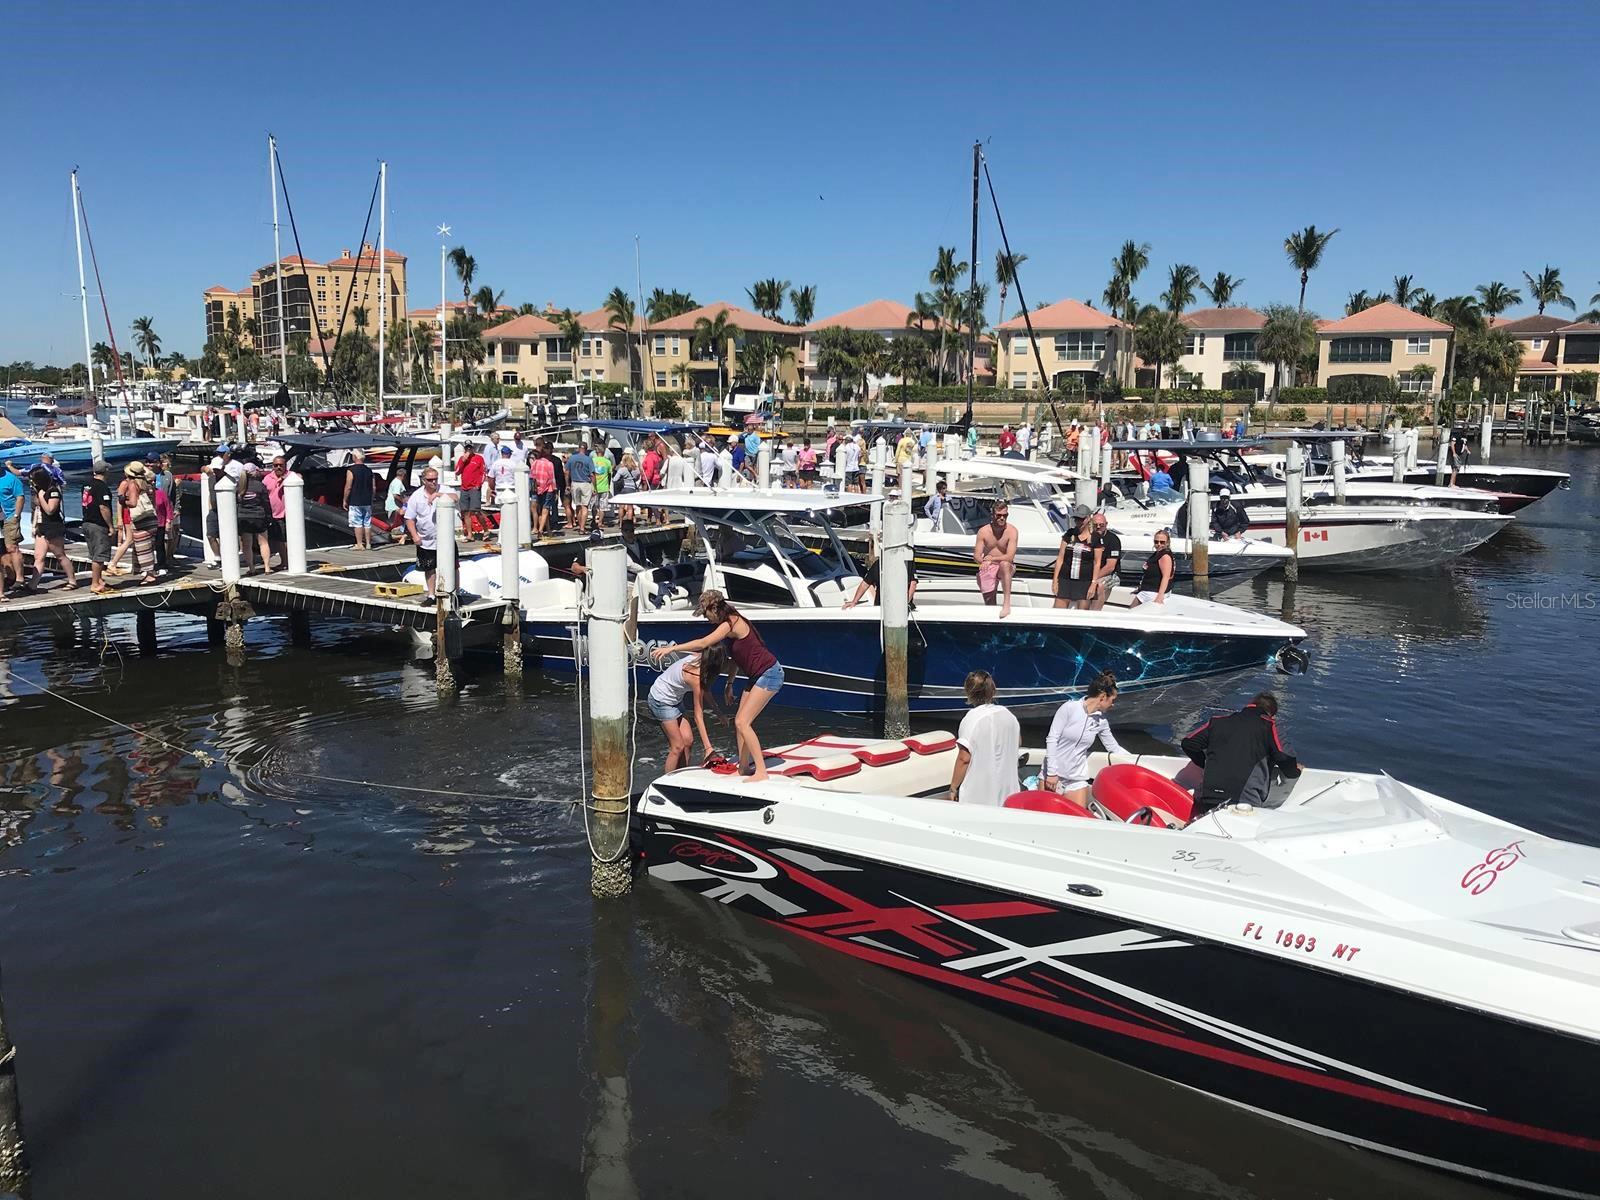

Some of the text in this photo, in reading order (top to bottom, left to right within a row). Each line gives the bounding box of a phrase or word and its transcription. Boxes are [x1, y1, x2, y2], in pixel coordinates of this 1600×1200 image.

[1171, 849, 1201, 862] 35
[1461, 840, 1527, 896] SST
[1242, 922, 1361, 962] FL 1893 NT
